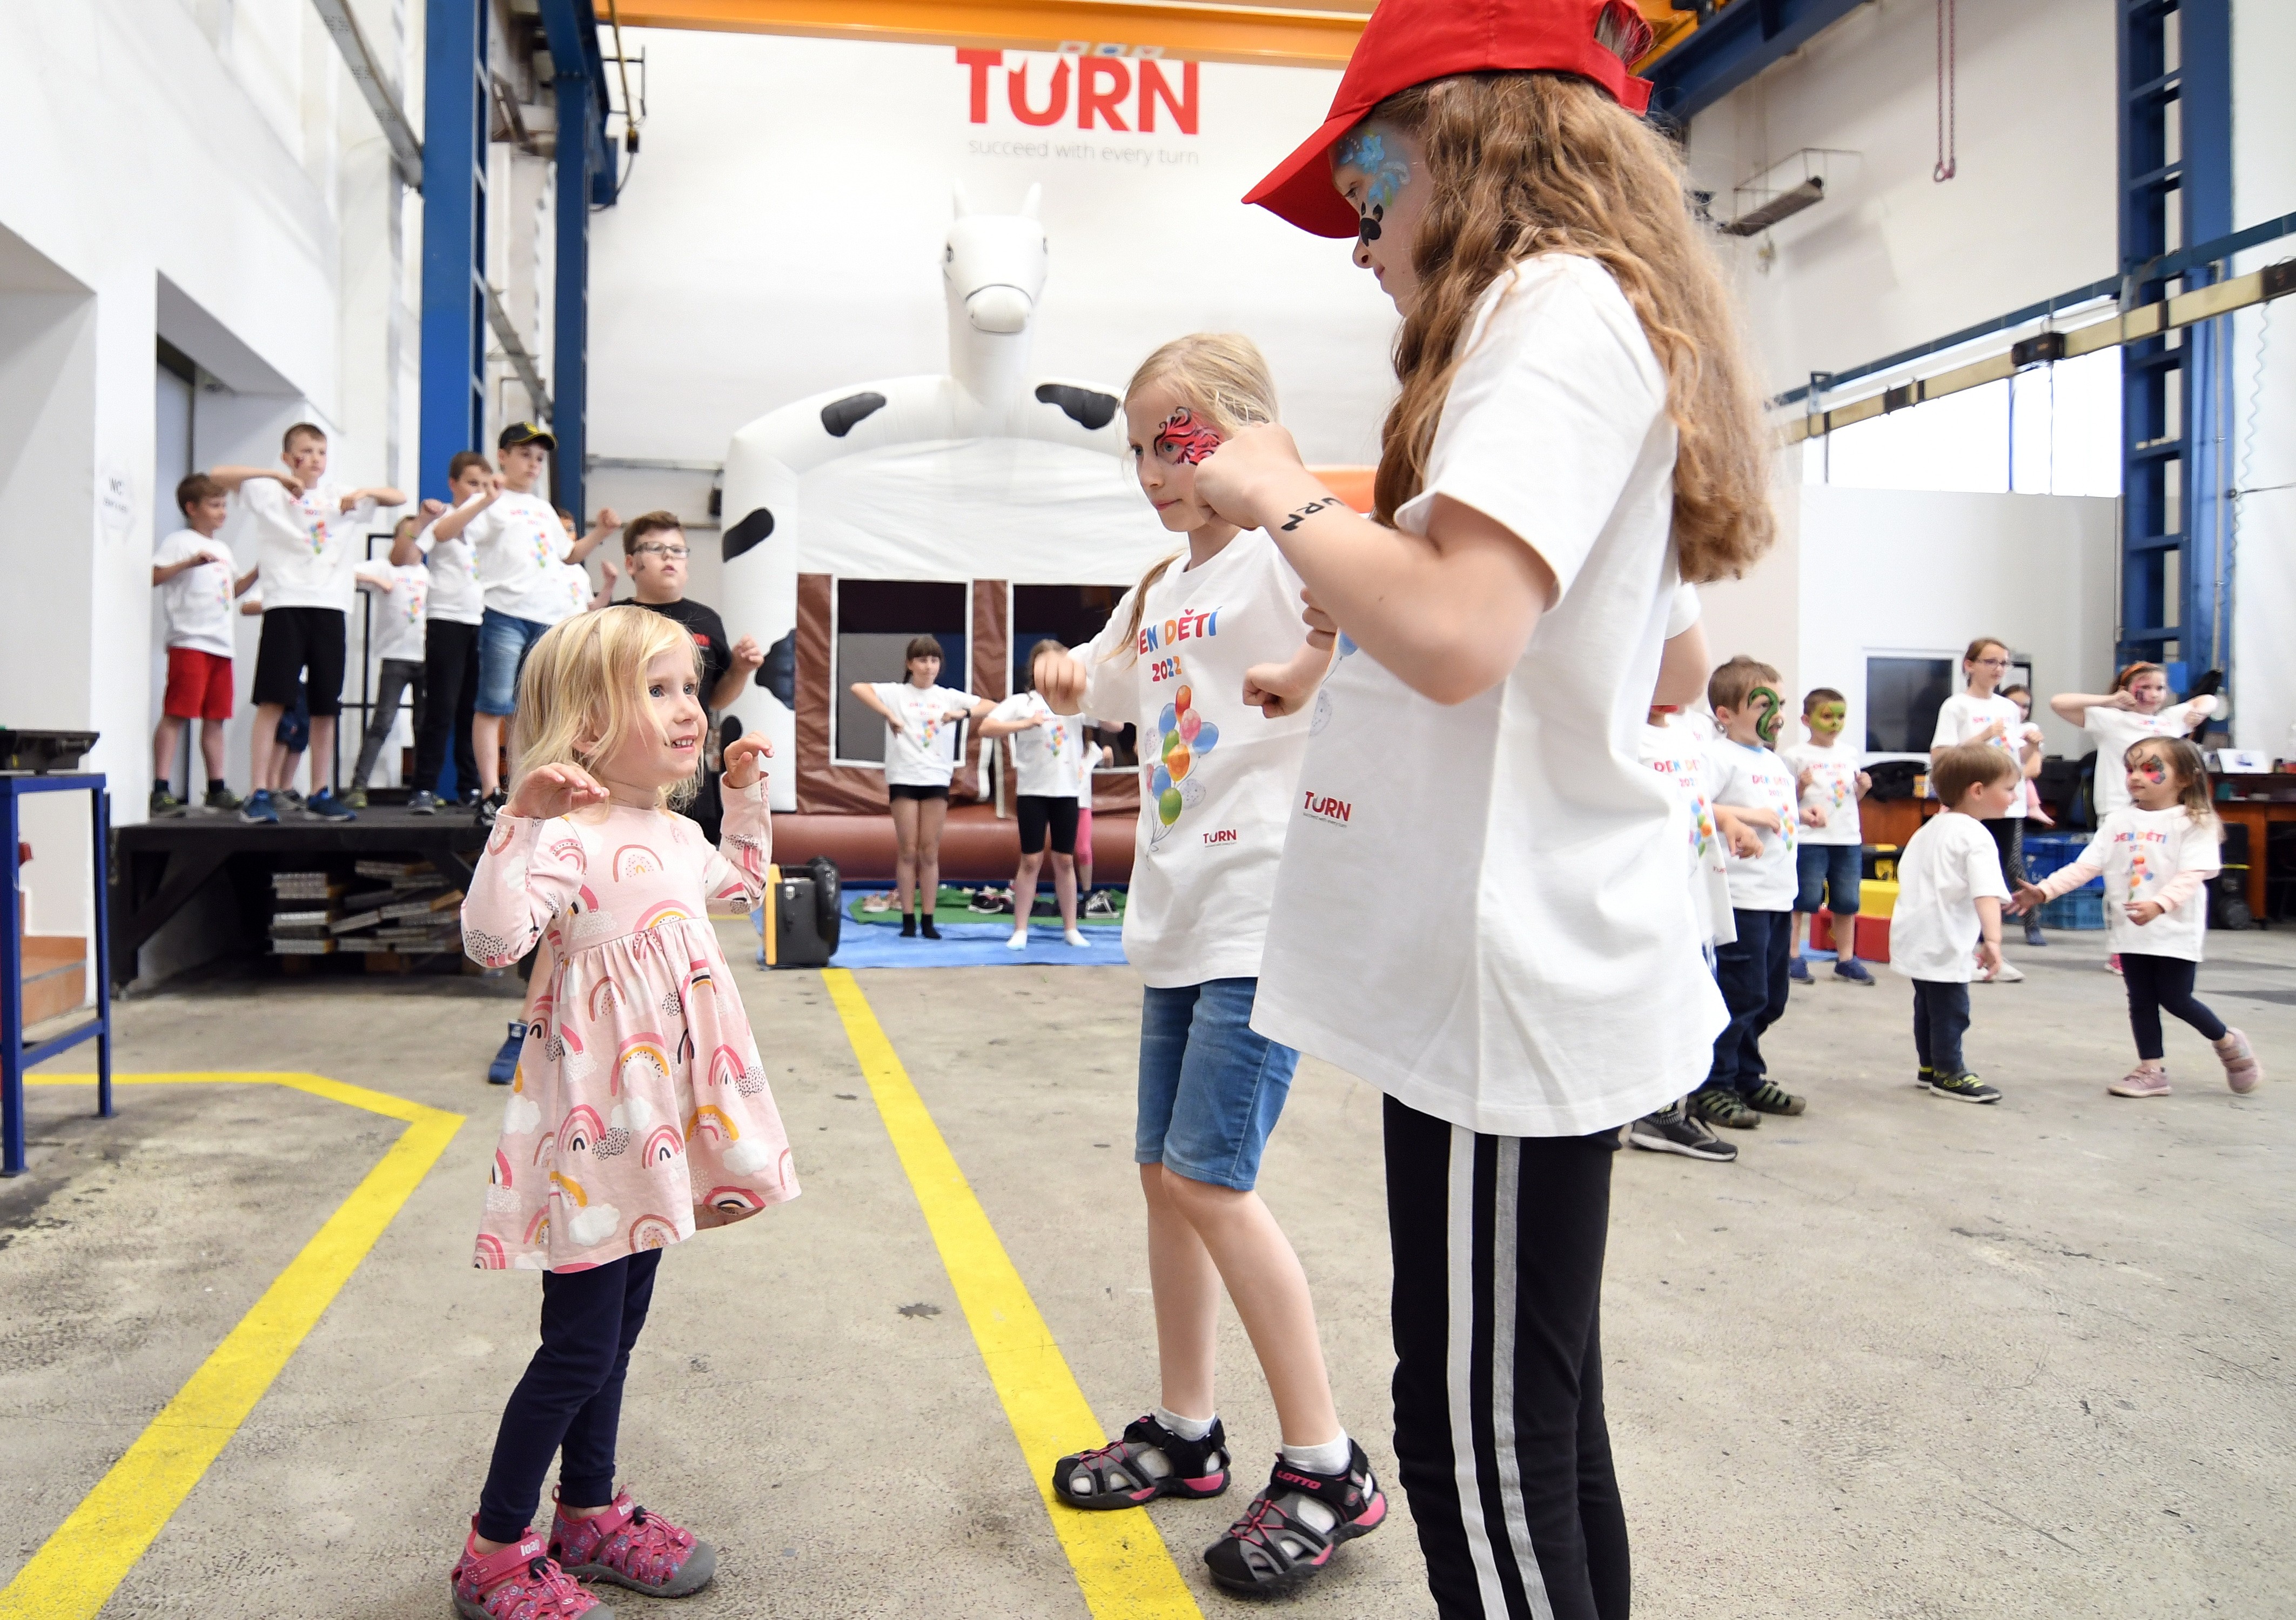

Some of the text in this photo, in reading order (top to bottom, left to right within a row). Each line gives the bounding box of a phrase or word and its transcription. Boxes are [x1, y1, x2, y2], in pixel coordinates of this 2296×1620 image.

[955, 47, 1199, 135] TURN
[969, 139, 1199, 166] succeed with every turn
[109, 477, 122, 496] WC
[1137, 606, 1223, 655] EN DĚTÍ
[1152, 655, 1182, 682] 2022
[1303, 791, 1352, 821] TURN
[1203, 829, 1237, 844] TURN
[1276, 1470, 1321, 1490] LOTTO
